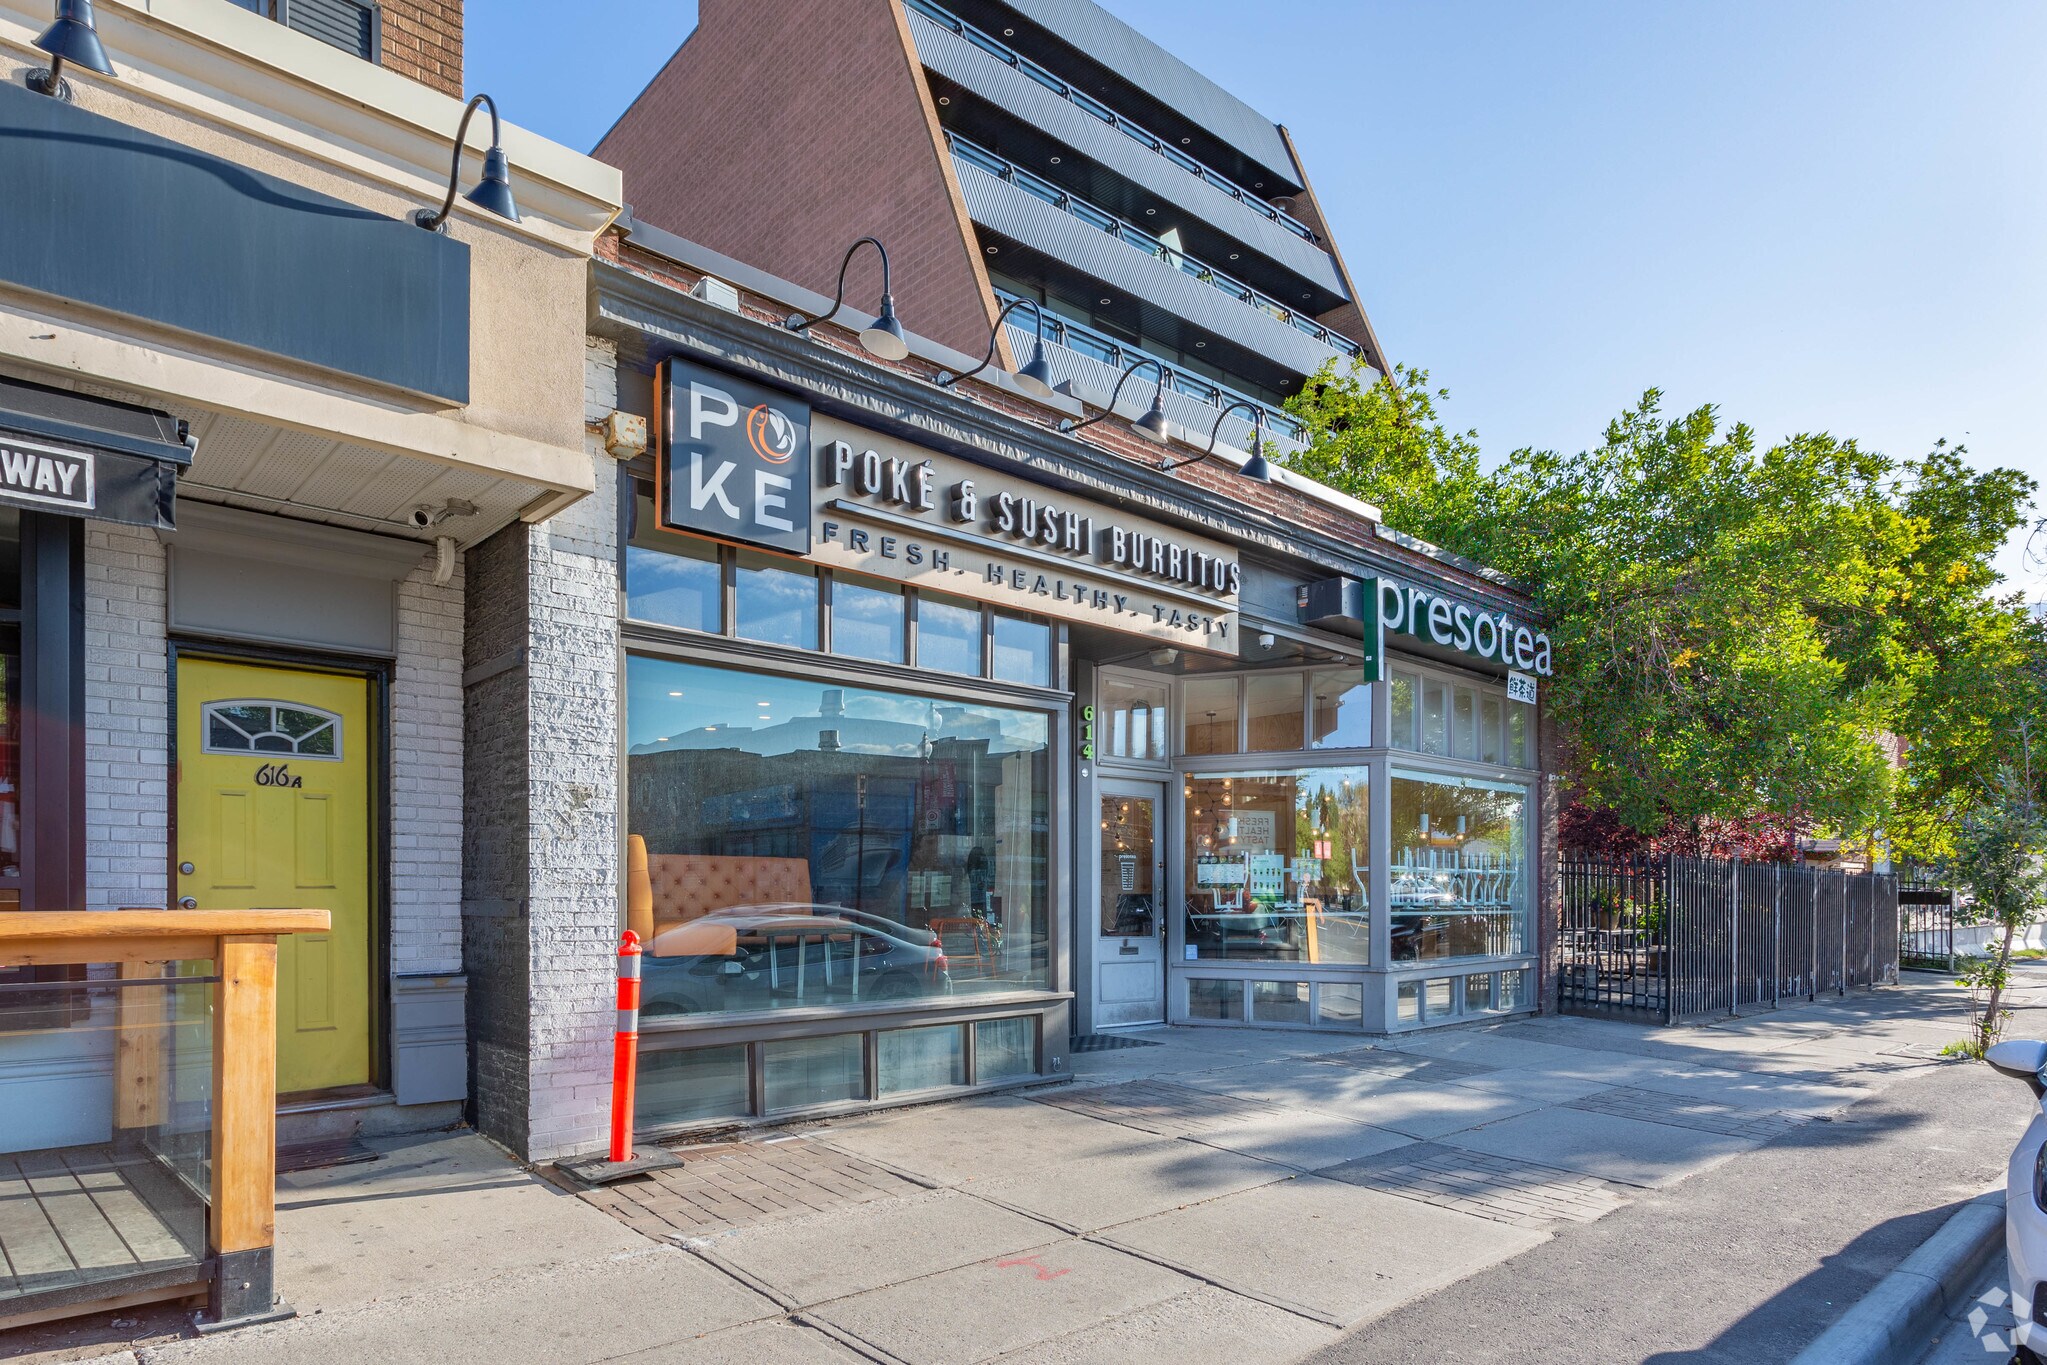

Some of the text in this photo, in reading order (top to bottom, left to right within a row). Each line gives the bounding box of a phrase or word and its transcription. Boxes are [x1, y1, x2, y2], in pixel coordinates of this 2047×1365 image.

[0, 449, 80, 496] WAY
[827, 439, 1241, 595] POKÉ & SUSHI BURRITOS
[1152, 604, 1230, 638] TASTY
[1372, 576, 1554, 682] presotea
[1082, 704, 1095, 760] 614
